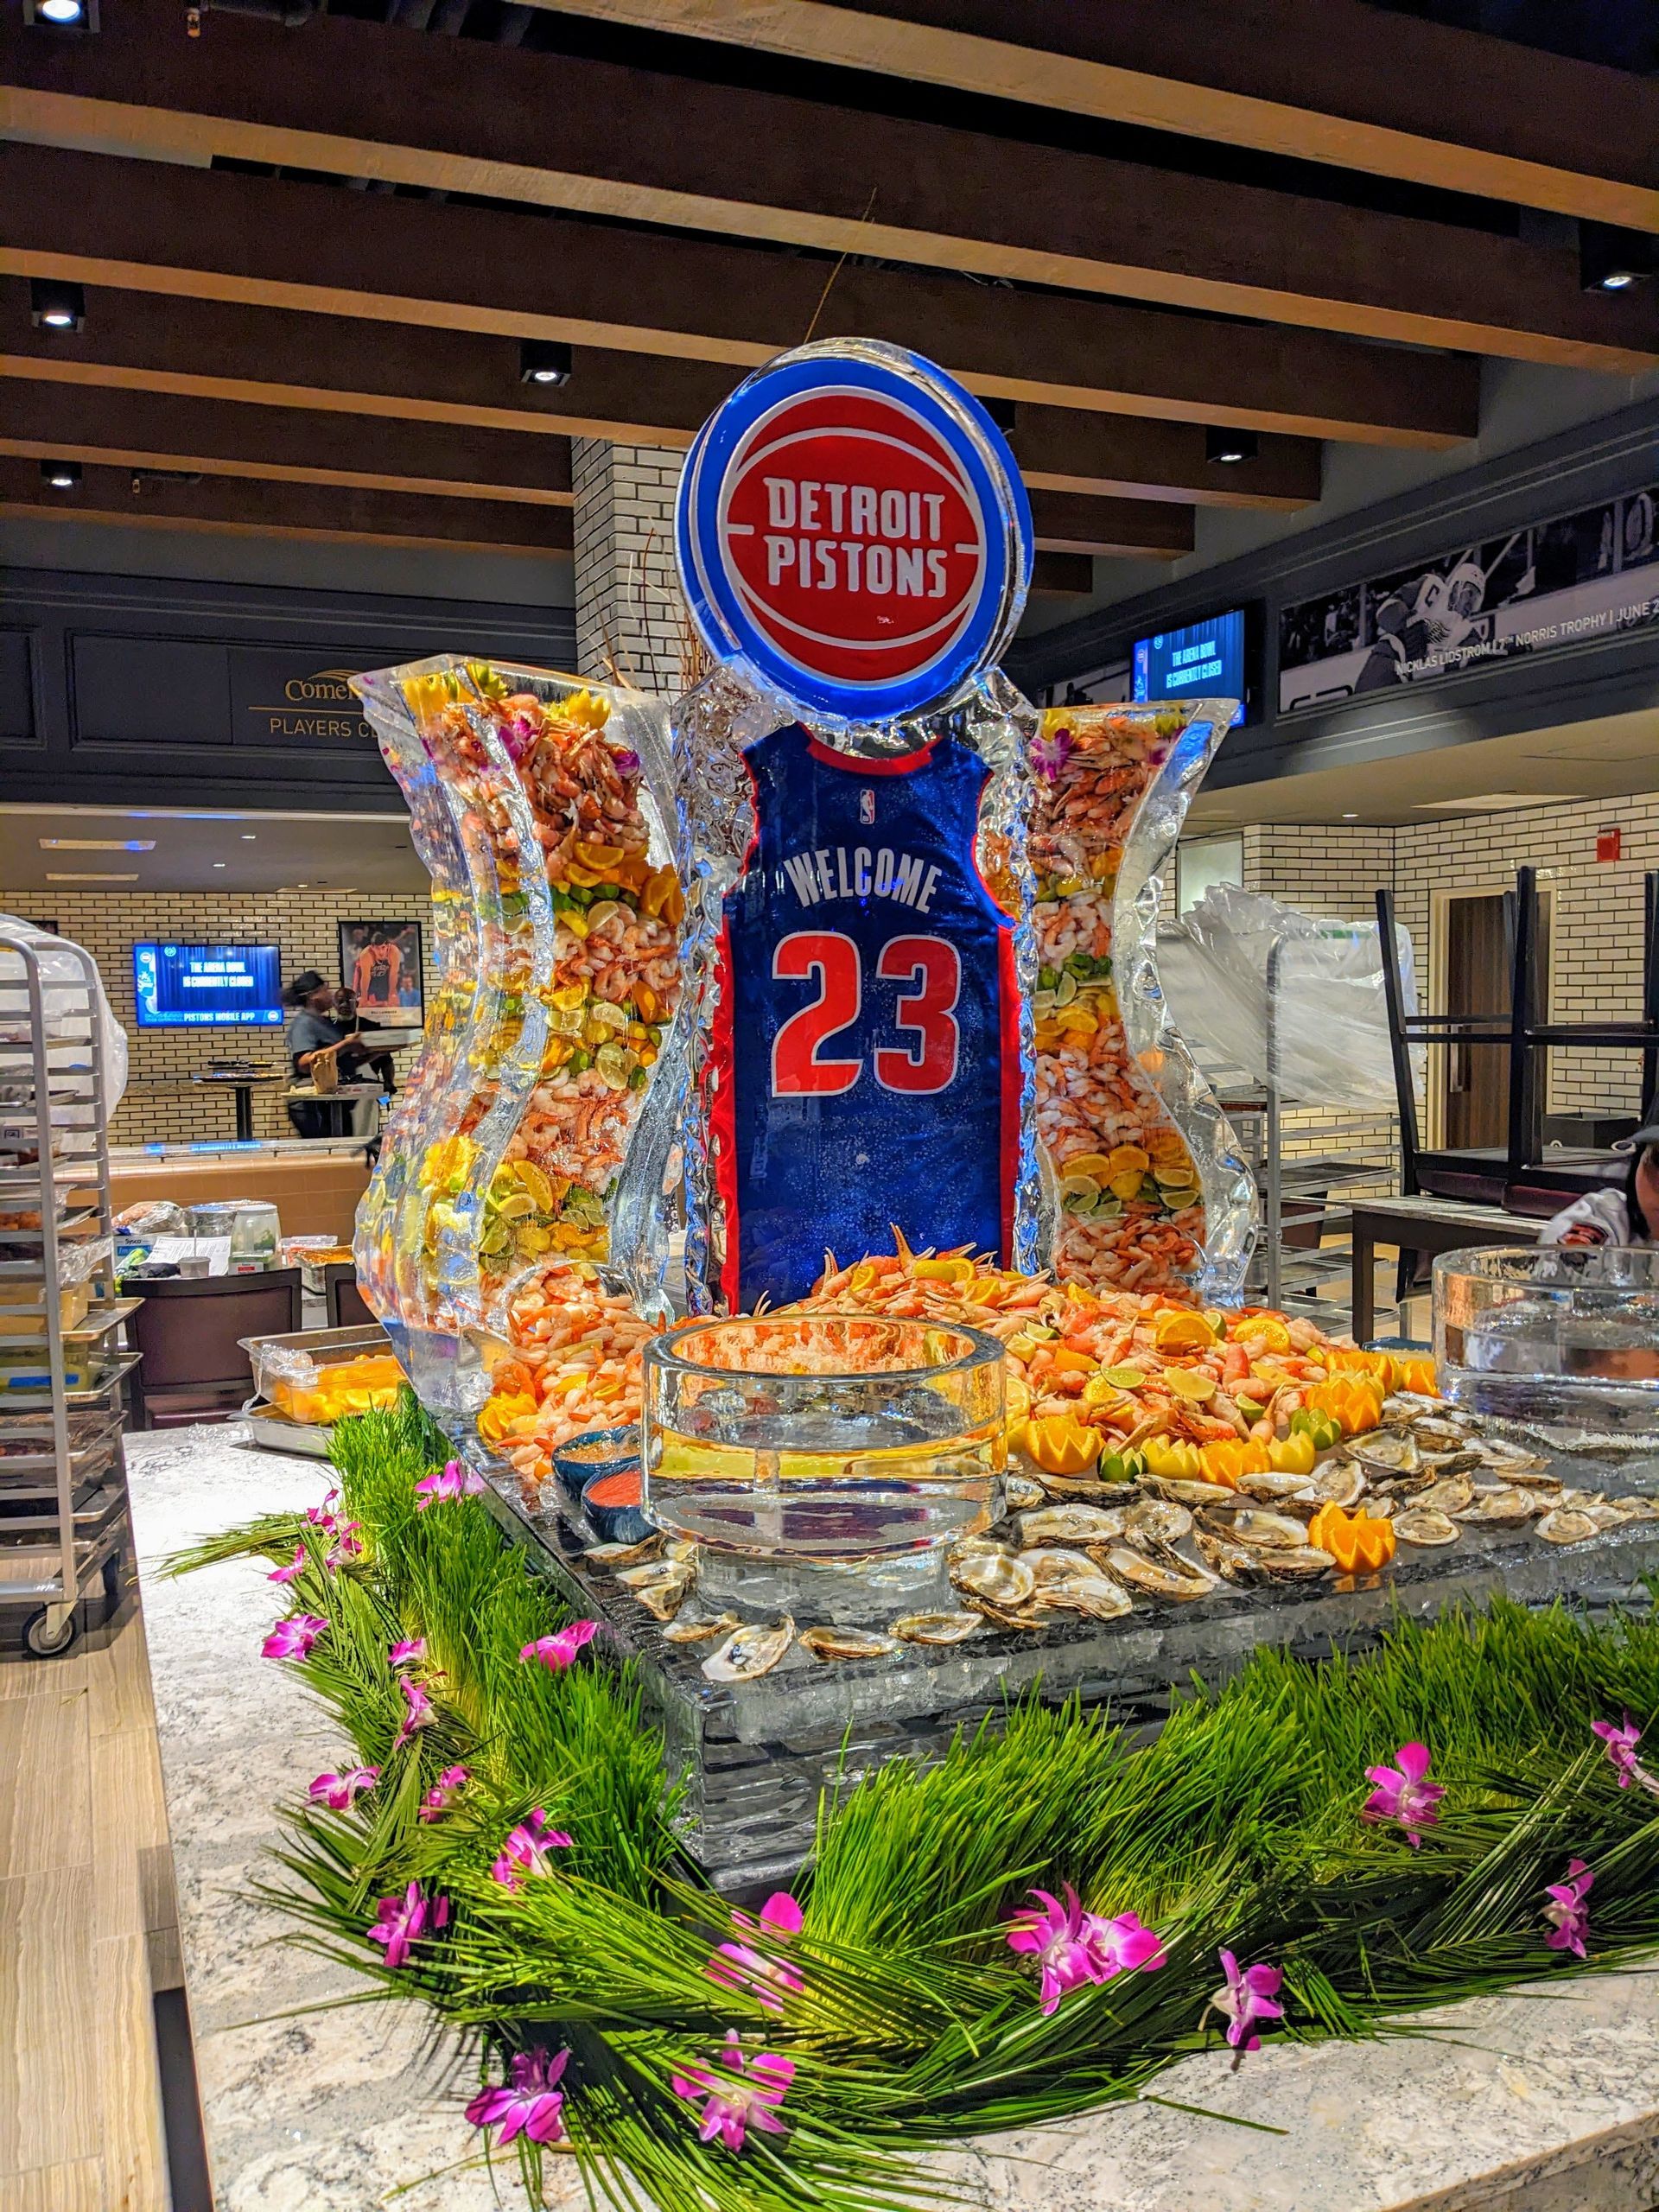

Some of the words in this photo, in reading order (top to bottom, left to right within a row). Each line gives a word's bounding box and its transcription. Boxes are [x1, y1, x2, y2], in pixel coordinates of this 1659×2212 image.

[762, 477, 945, 542] DETROIT
[763, 535, 948, 598] PISTONS
[1173, 651, 1182, 667] THE
[1395, 655, 1437, 676] NICKLAS
[1440, 642, 1490, 664] LIDSTROM
[1515, 625, 1557, 647] NORRIS
[1560, 612, 1606, 636] TROPHY
[1617, 601, 1650, 622] JUNE
[270, 718, 352, 737] PLAYERS
[783, 847, 943, 913] WELCOME
[189, 962, 202, 973] THE
[184, 1013, 213, 1021] PISTONS
[215, 1012, 239, 1021] MOBILE
[241, 1012, 255, 1021] APP
[771, 931, 962, 1097] 23
